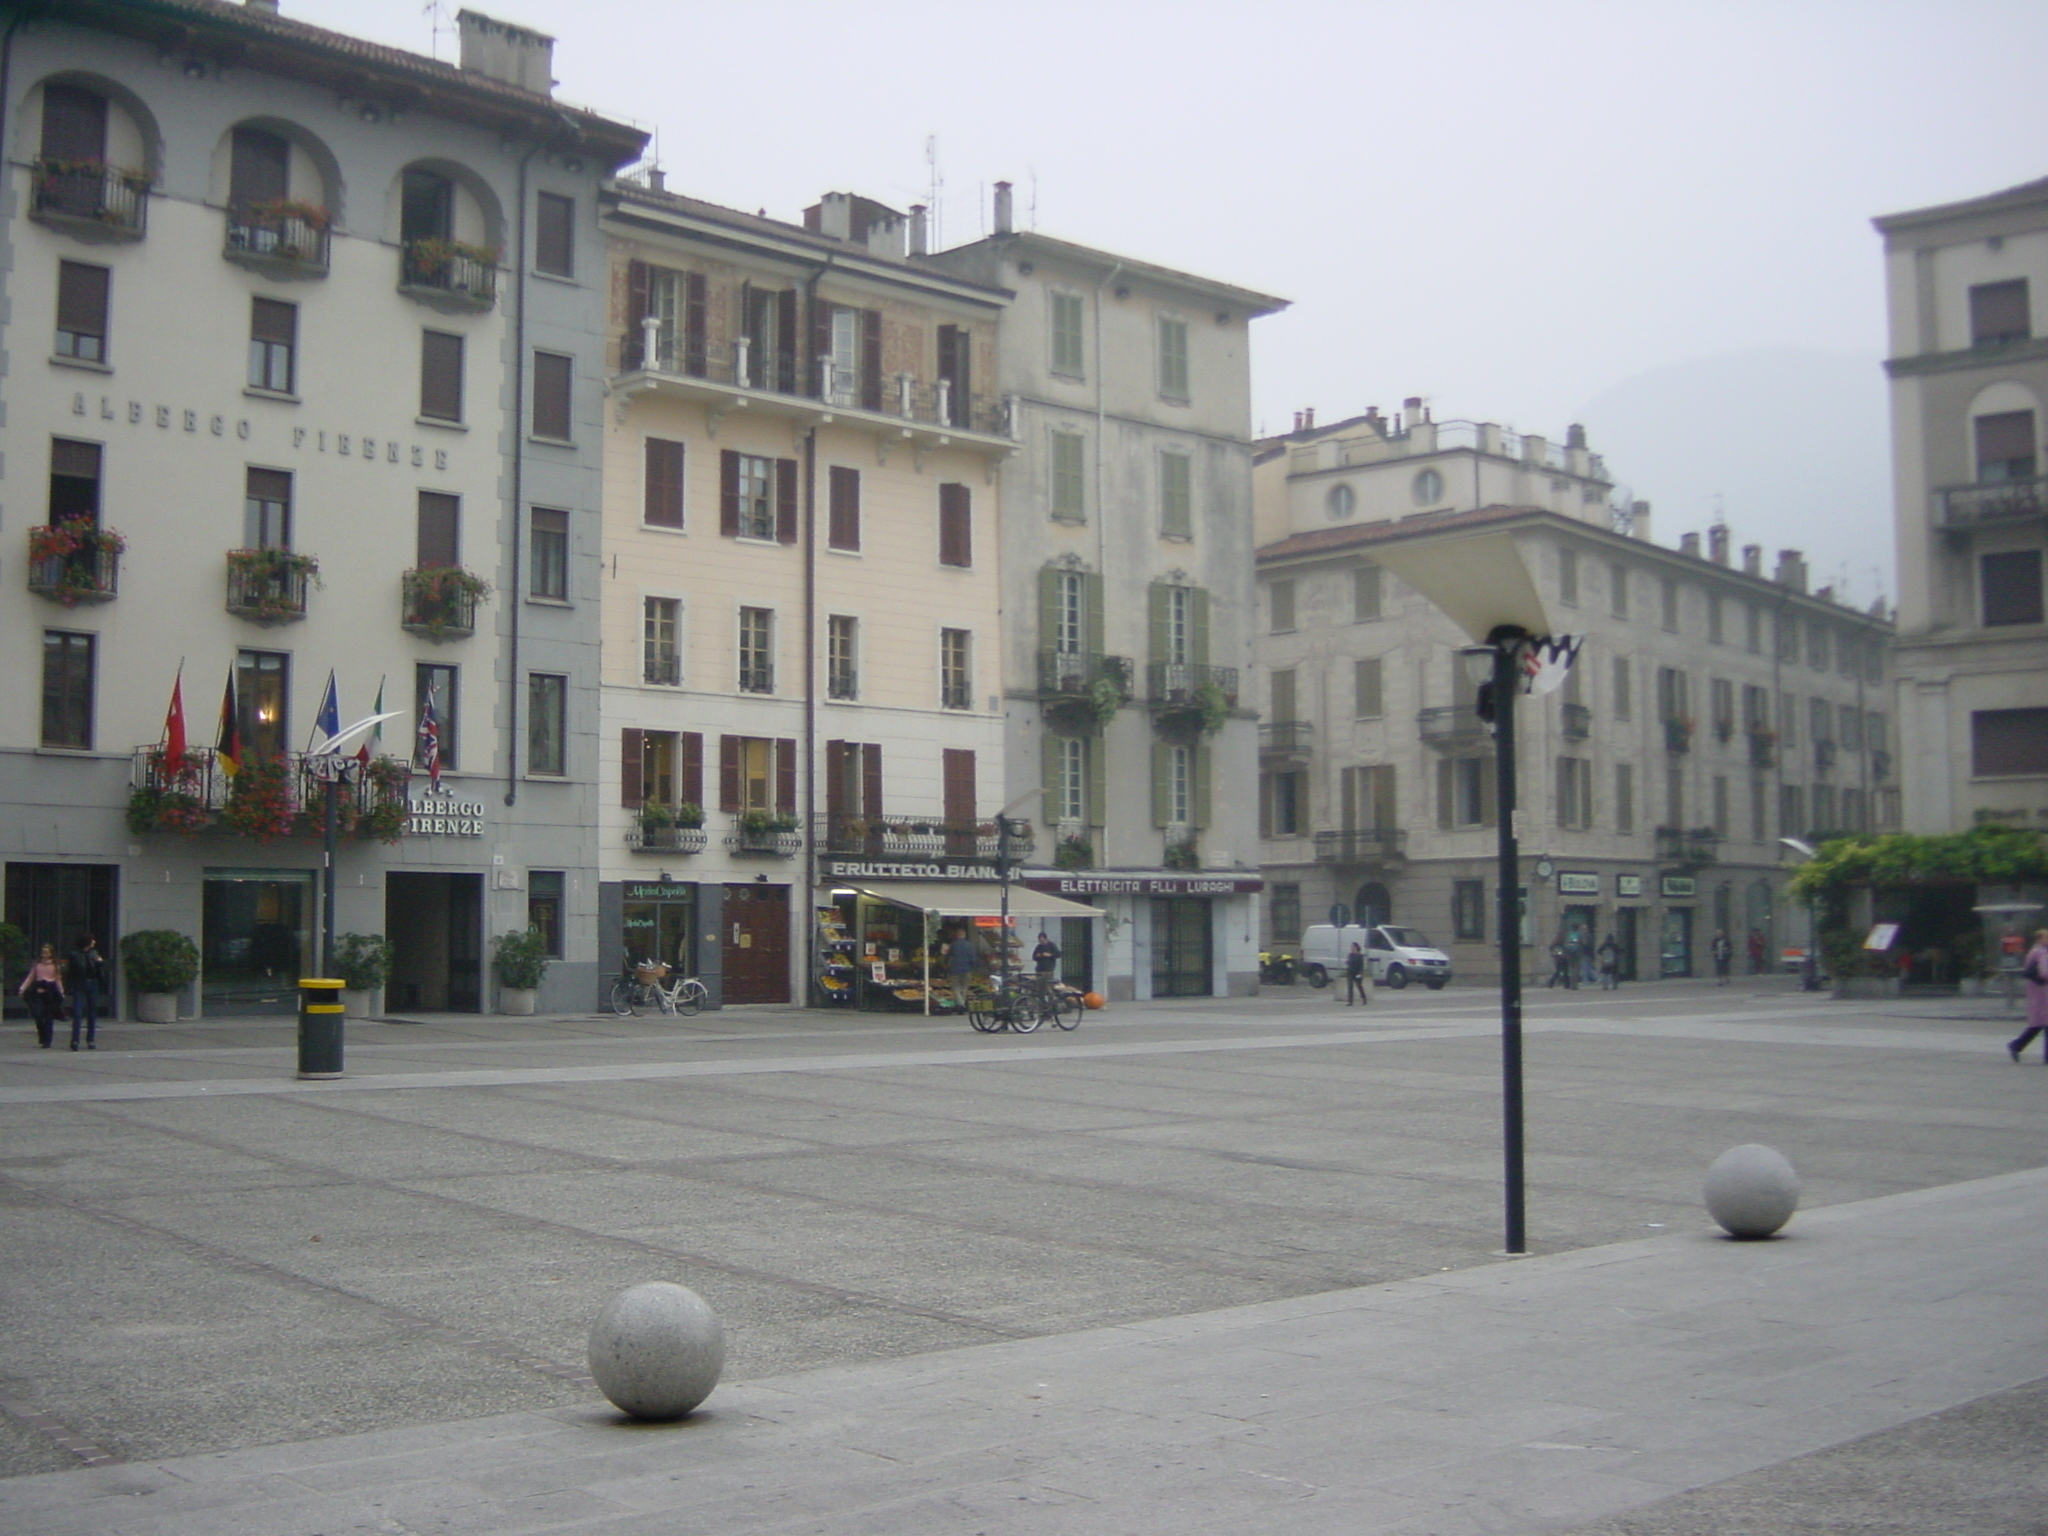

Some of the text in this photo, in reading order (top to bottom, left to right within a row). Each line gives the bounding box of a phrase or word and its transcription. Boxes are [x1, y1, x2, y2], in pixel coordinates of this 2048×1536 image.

[72, 392, 446, 470] ALBERGO FIRENZE
[409, 799, 484, 817] LBERGO
[403, 817, 484, 835] IRENZE
